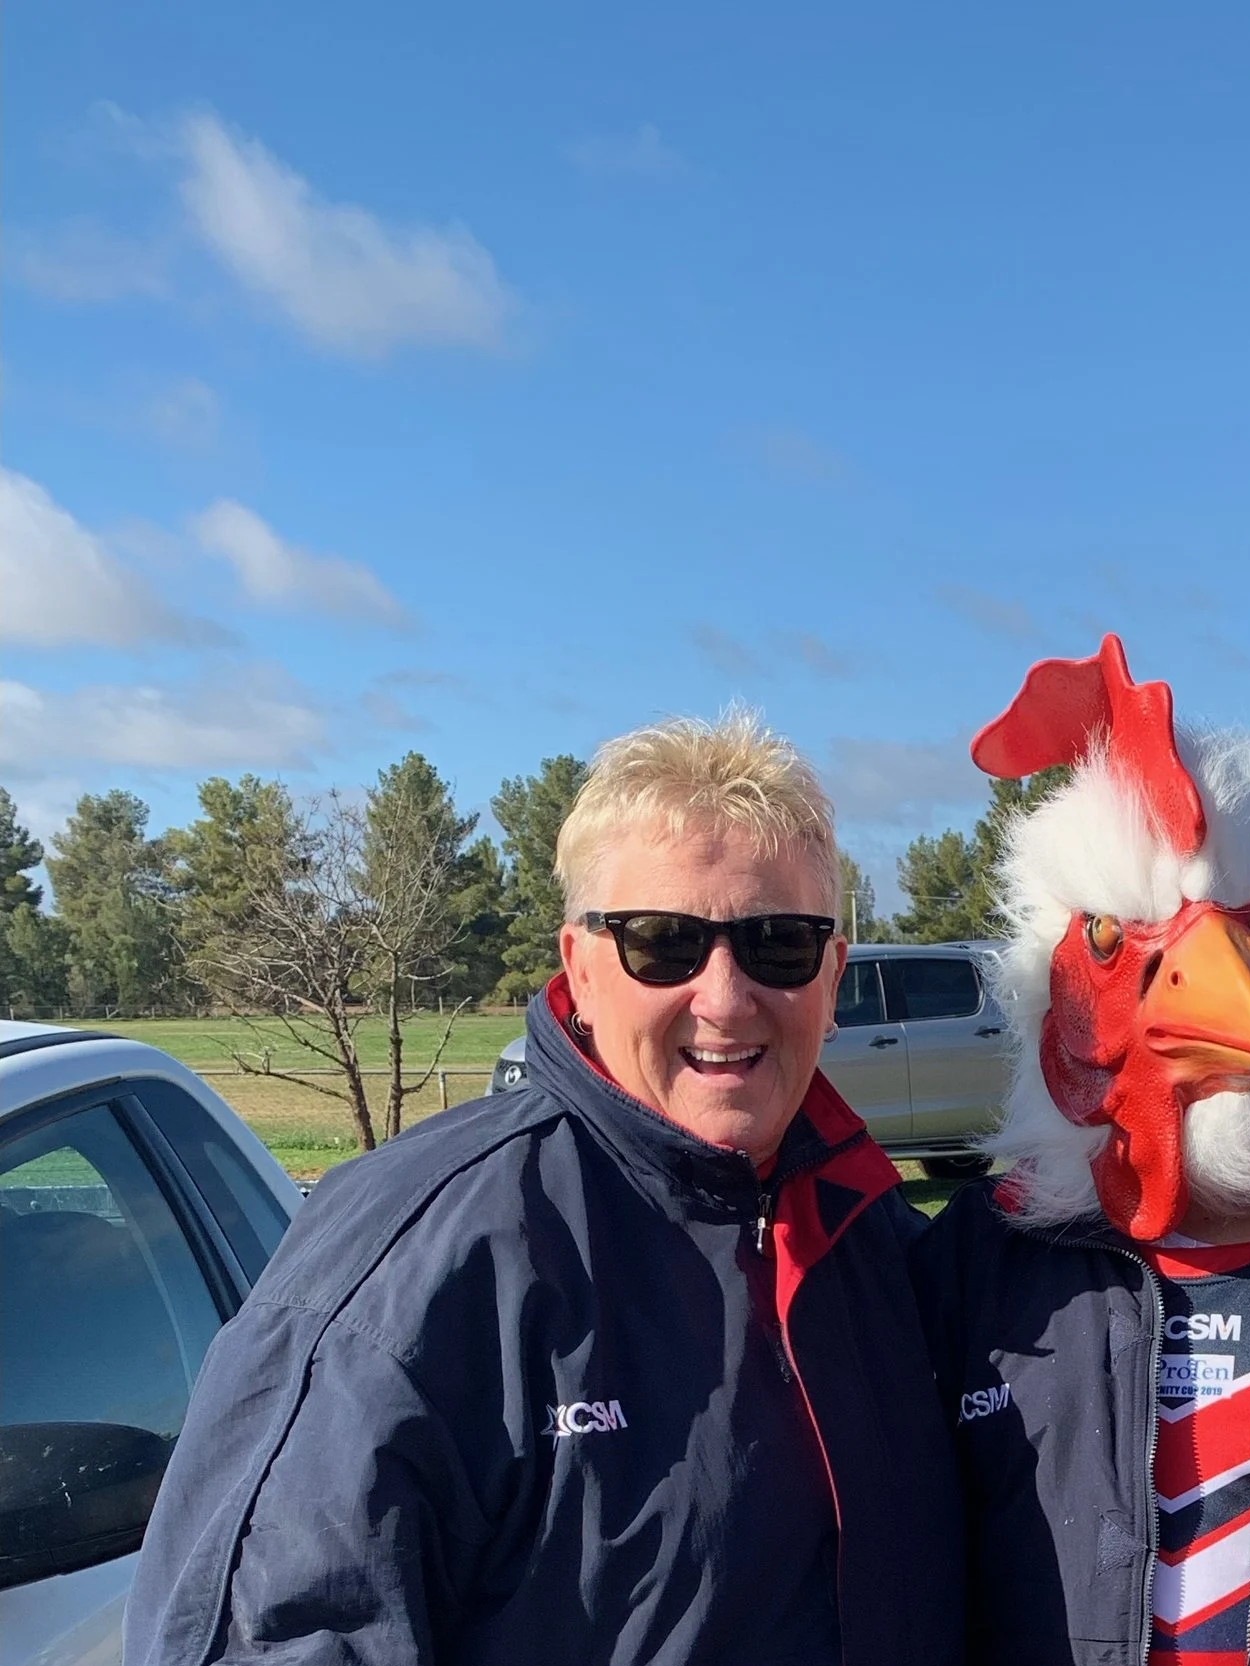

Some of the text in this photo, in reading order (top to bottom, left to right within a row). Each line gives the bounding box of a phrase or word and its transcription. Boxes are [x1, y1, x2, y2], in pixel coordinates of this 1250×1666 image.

[1164, 1313, 1242, 1341] CSM
[962, 1383, 1010, 1420] CSM
[1200, 1387, 1223, 1396] 2019
[566, 1400, 628, 1434] CSM
